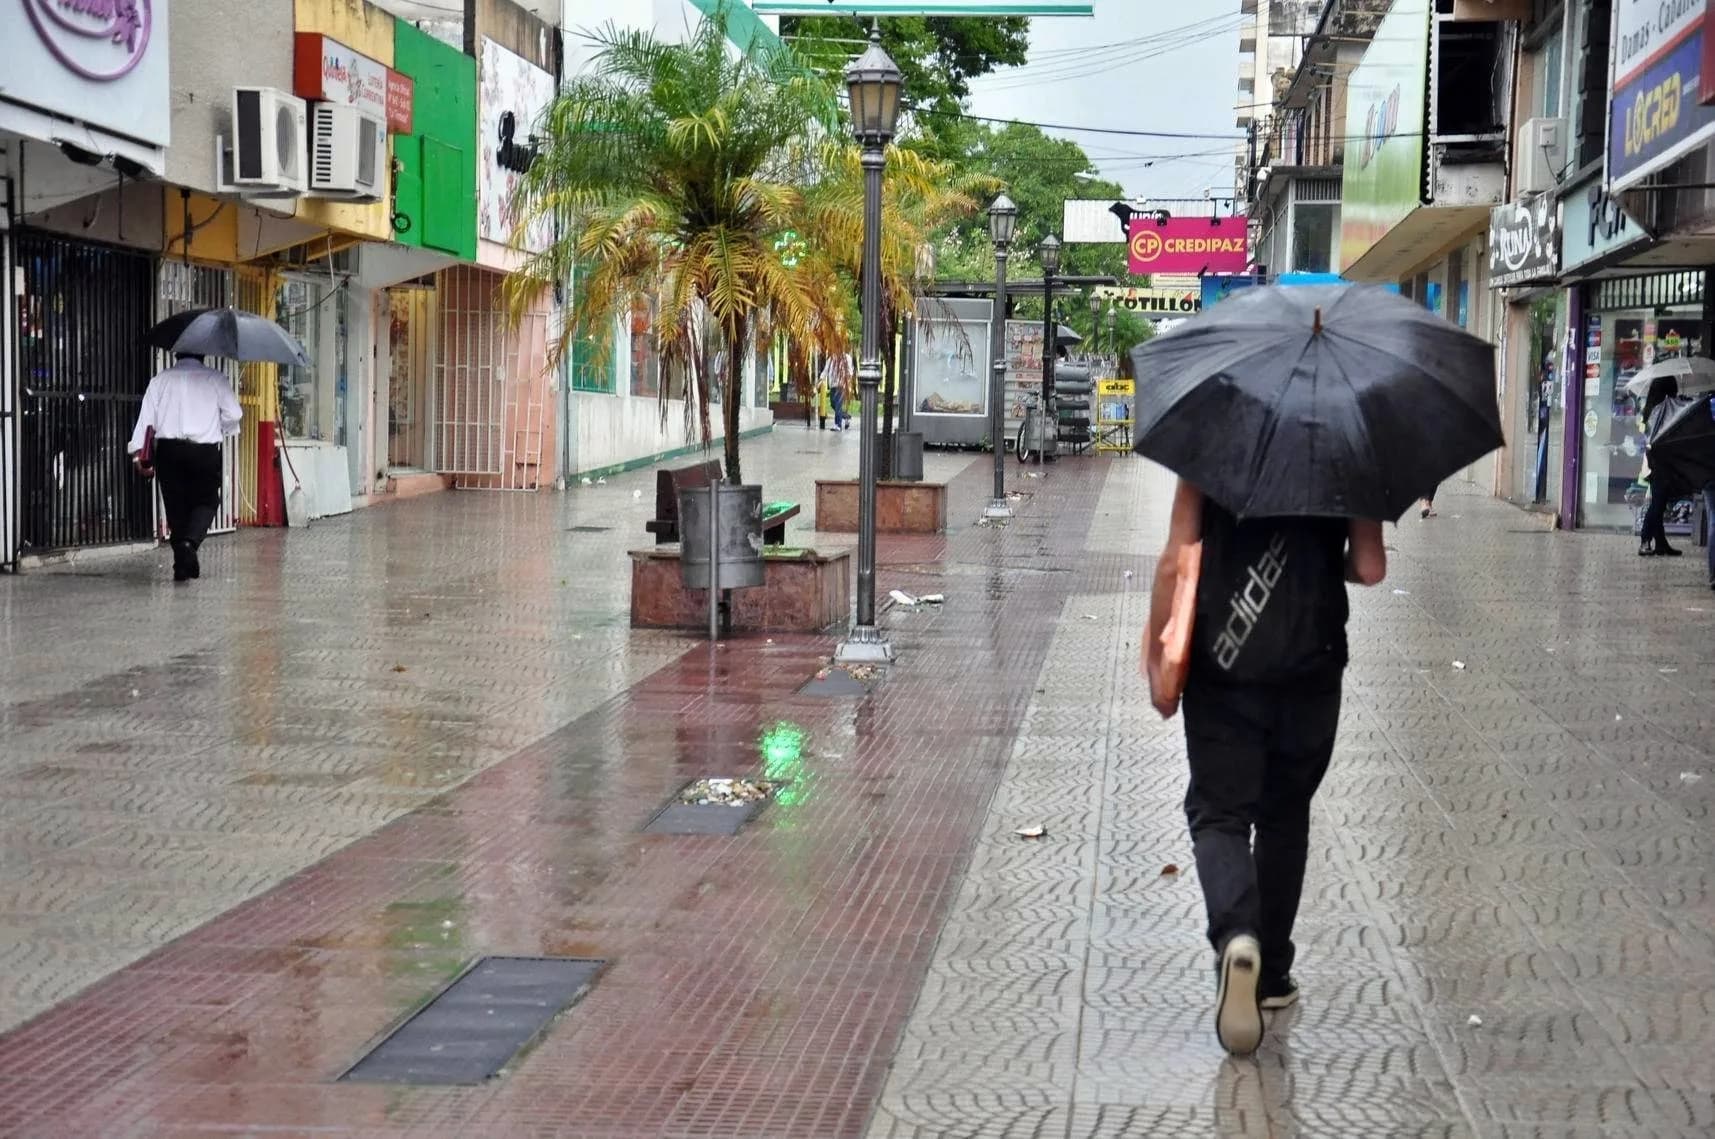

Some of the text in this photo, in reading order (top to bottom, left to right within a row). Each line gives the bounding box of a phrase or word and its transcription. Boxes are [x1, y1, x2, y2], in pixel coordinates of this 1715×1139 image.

[1621, 21, 1649, 64] Damas
[1625, 72, 1681, 157] LOCRED
[1135, 238, 1245, 254] CP CREDIPAZ
[1588, 351, 1600, 361] VISA
[1213, 532, 1288, 671] adidas
